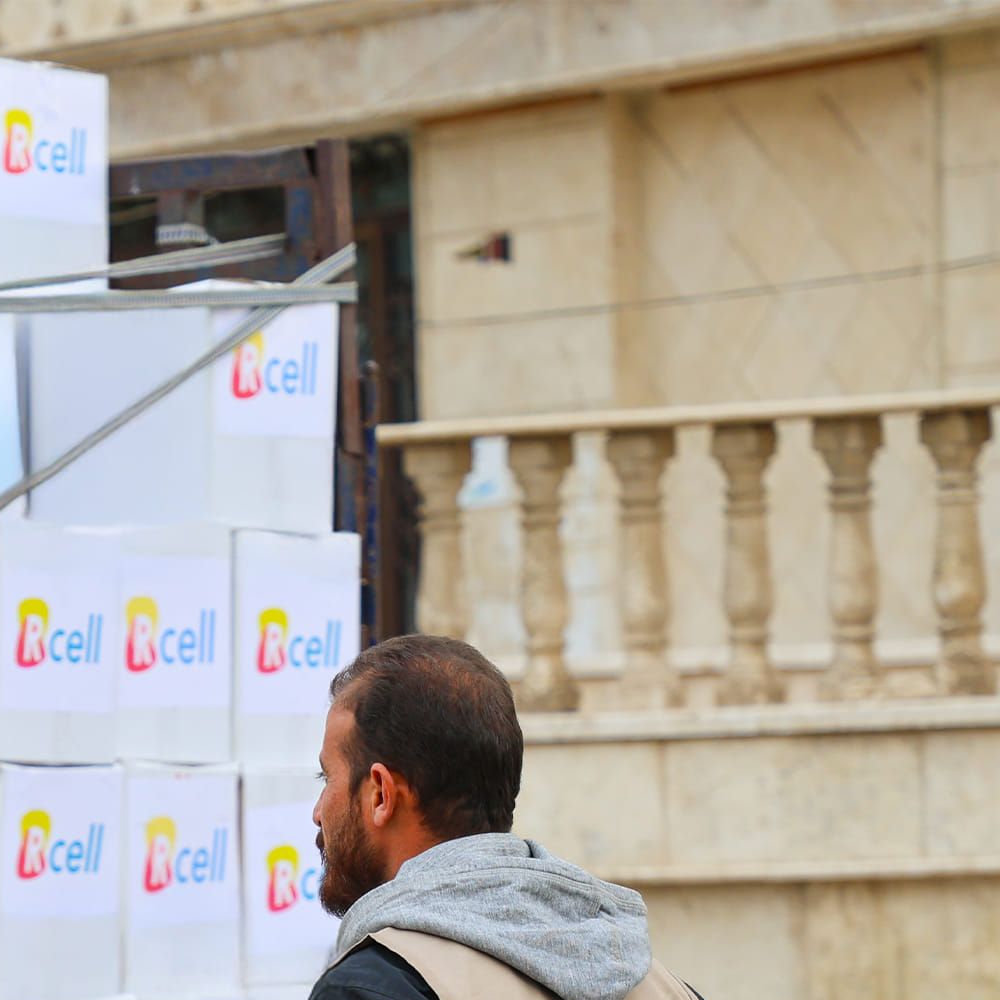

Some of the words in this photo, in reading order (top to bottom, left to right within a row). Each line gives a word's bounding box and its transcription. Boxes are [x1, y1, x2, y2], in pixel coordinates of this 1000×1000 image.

[8, 124, 87, 177] Rcell
[237, 343, 319, 397] Rcell
[21, 614, 104, 666] Rcell
[131, 609, 217, 667] Rcell
[262, 621, 343, 670] Rcell
[22, 824, 105, 876] Rcell
[149, 829, 228, 887] Rcell
